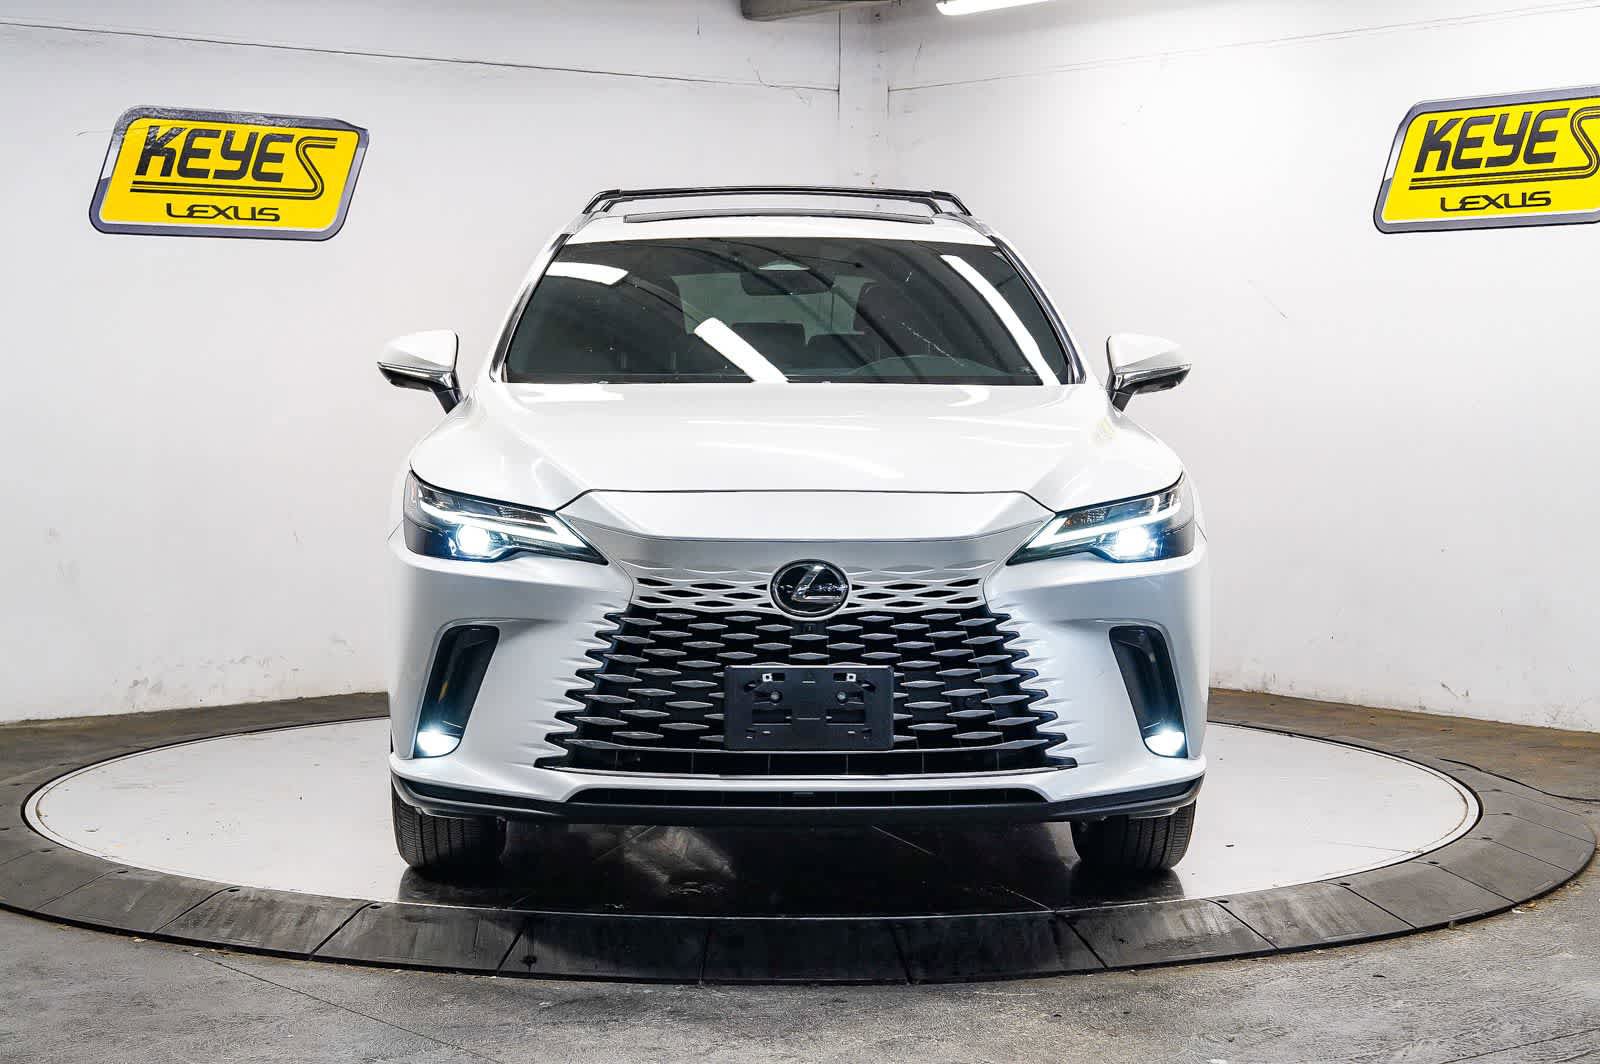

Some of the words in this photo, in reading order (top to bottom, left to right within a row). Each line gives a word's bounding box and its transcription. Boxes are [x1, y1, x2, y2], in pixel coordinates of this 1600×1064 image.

[134, 125, 338, 199] KEYES
[1413, 106, 1600, 178] KEYES
[166, 202, 280, 222] LEXUS
[1440, 191, 1552, 212] LEXUS
